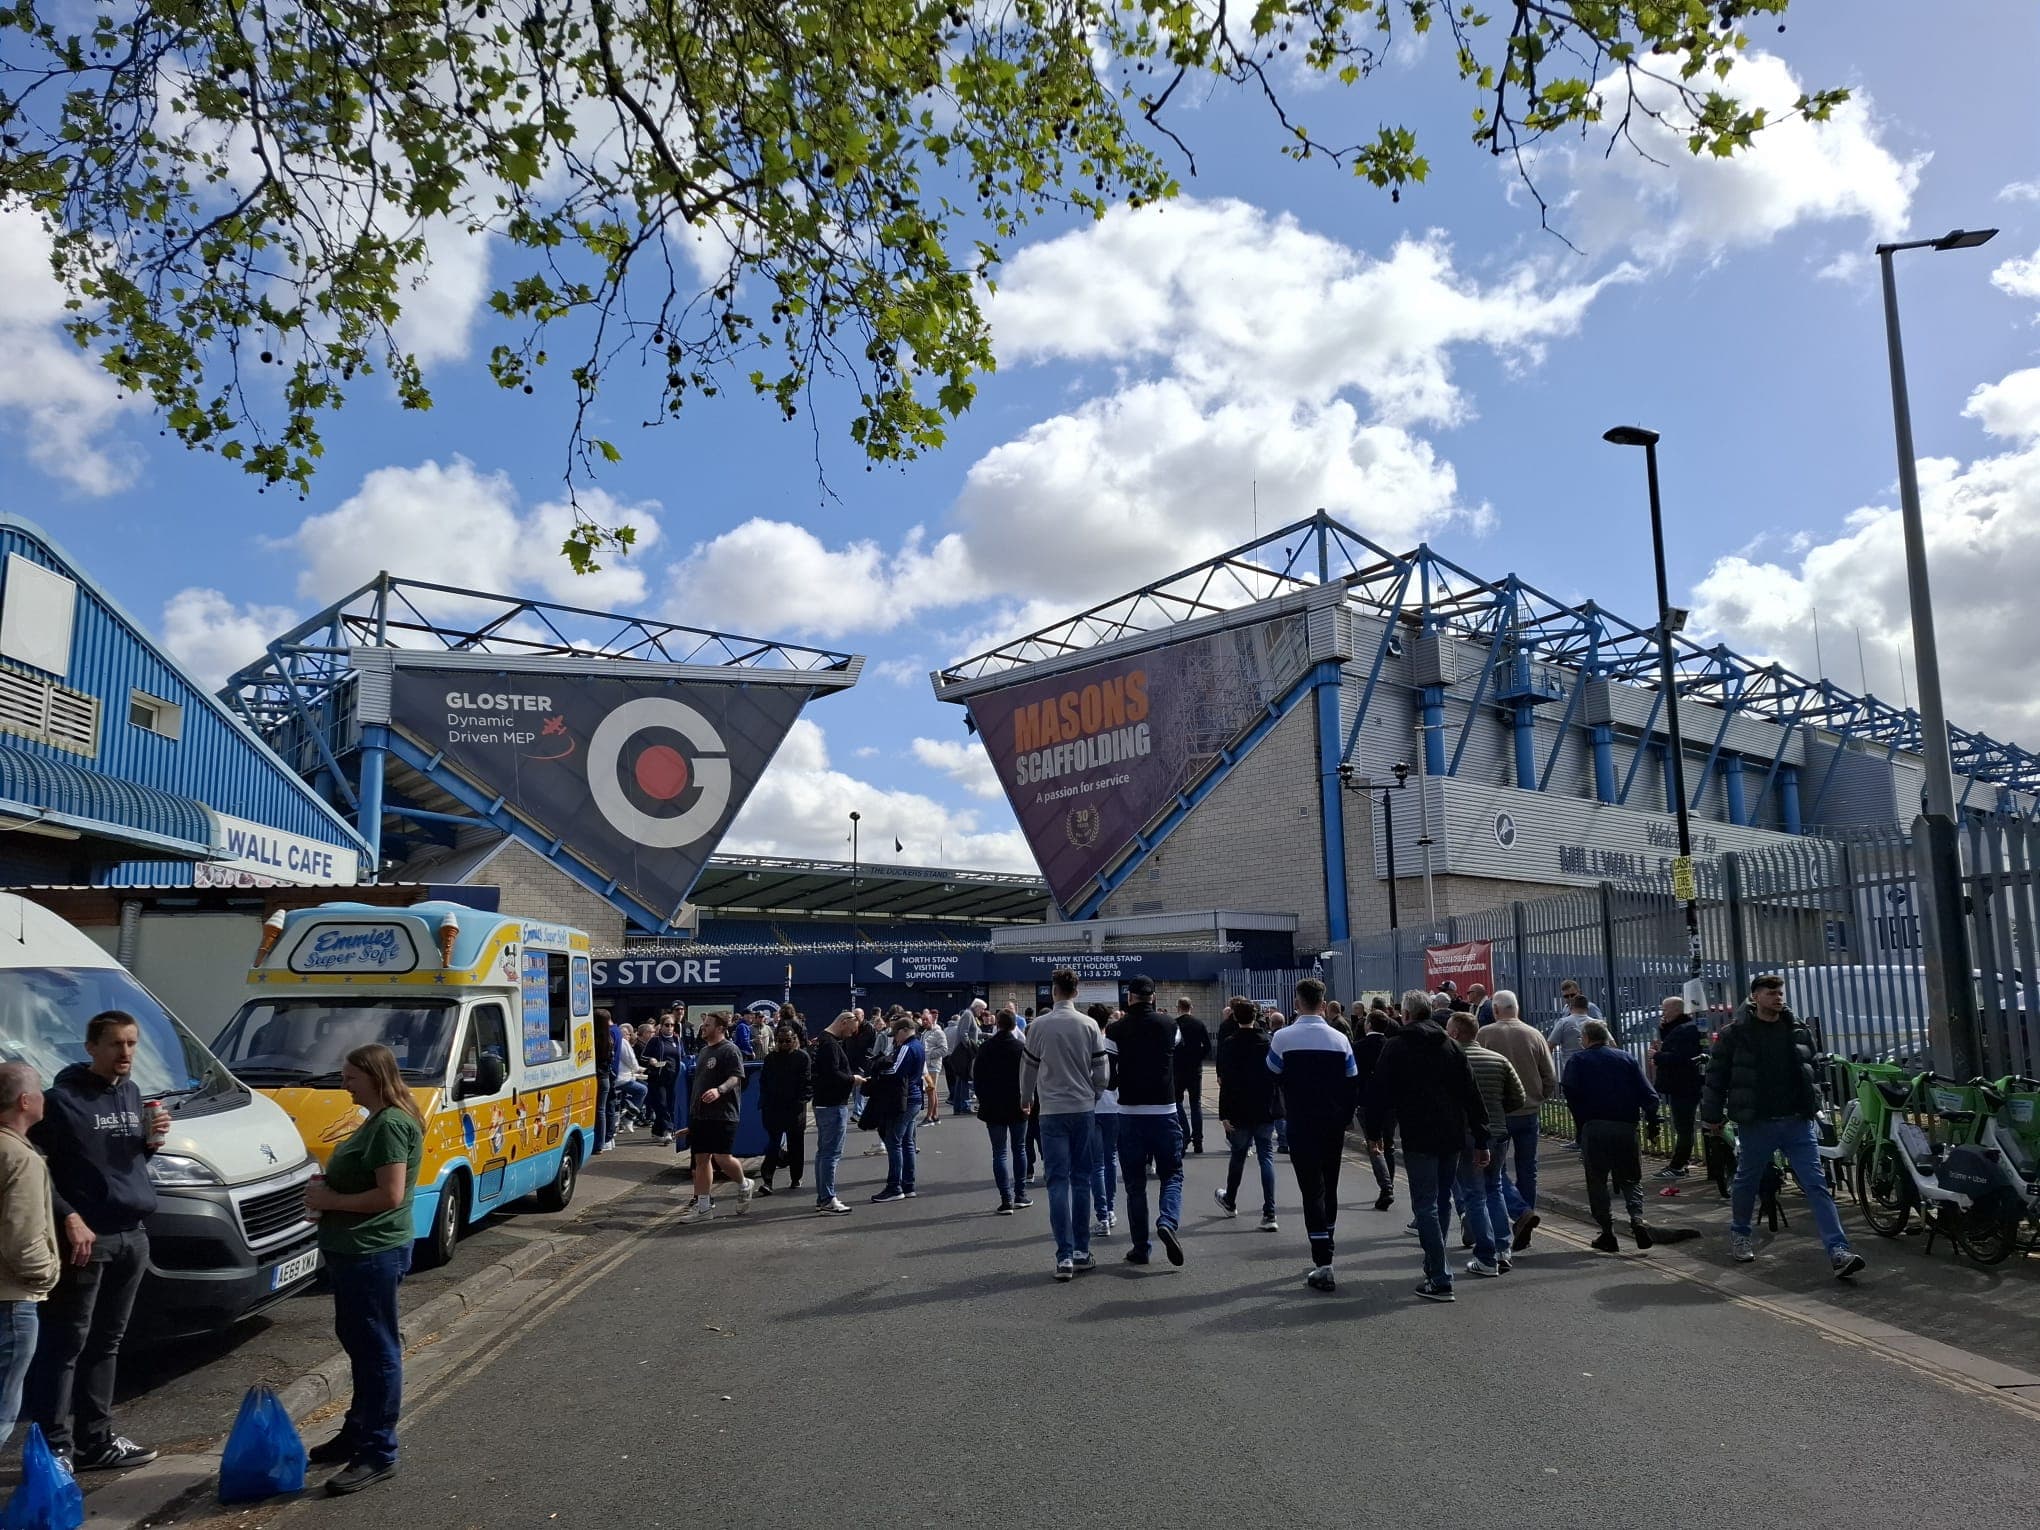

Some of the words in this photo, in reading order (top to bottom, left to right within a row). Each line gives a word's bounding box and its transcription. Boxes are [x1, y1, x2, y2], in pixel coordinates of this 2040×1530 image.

[446, 691, 552, 712] GLOSTER
[1013, 669, 1149, 753] MASONS
[447, 713, 514, 728] Dynamic
[448, 730, 498, 743] Driven
[503, 732, 535, 744] MEP
[1015, 722, 1151, 786] SCAFFOLDING
[1036, 792, 1043, 803] A
[1044, 785, 1078, 804] passion
[1080, 781, 1095, 793] for
[1095, 773, 1130, 790] service
[1076, 809, 1088, 823] 30
[227, 828, 282, 867] WALL
[288, 844, 333, 878] CAFE
[1673, 856, 1691, 870] CASH
[870, 866, 885, 875] THE
[923, 869, 948, 878] STAND
[314, 928, 396, 953] Emmie's
[304, 951, 356, 969] Super
[358, 944, 400, 967] Soft
[618, 959, 721, 985] STORE
[905, 971, 955, 979] SUPPORTERS
[93, 1113, 120, 1130] Jack
[277, 1259, 301, 1285] AE69
